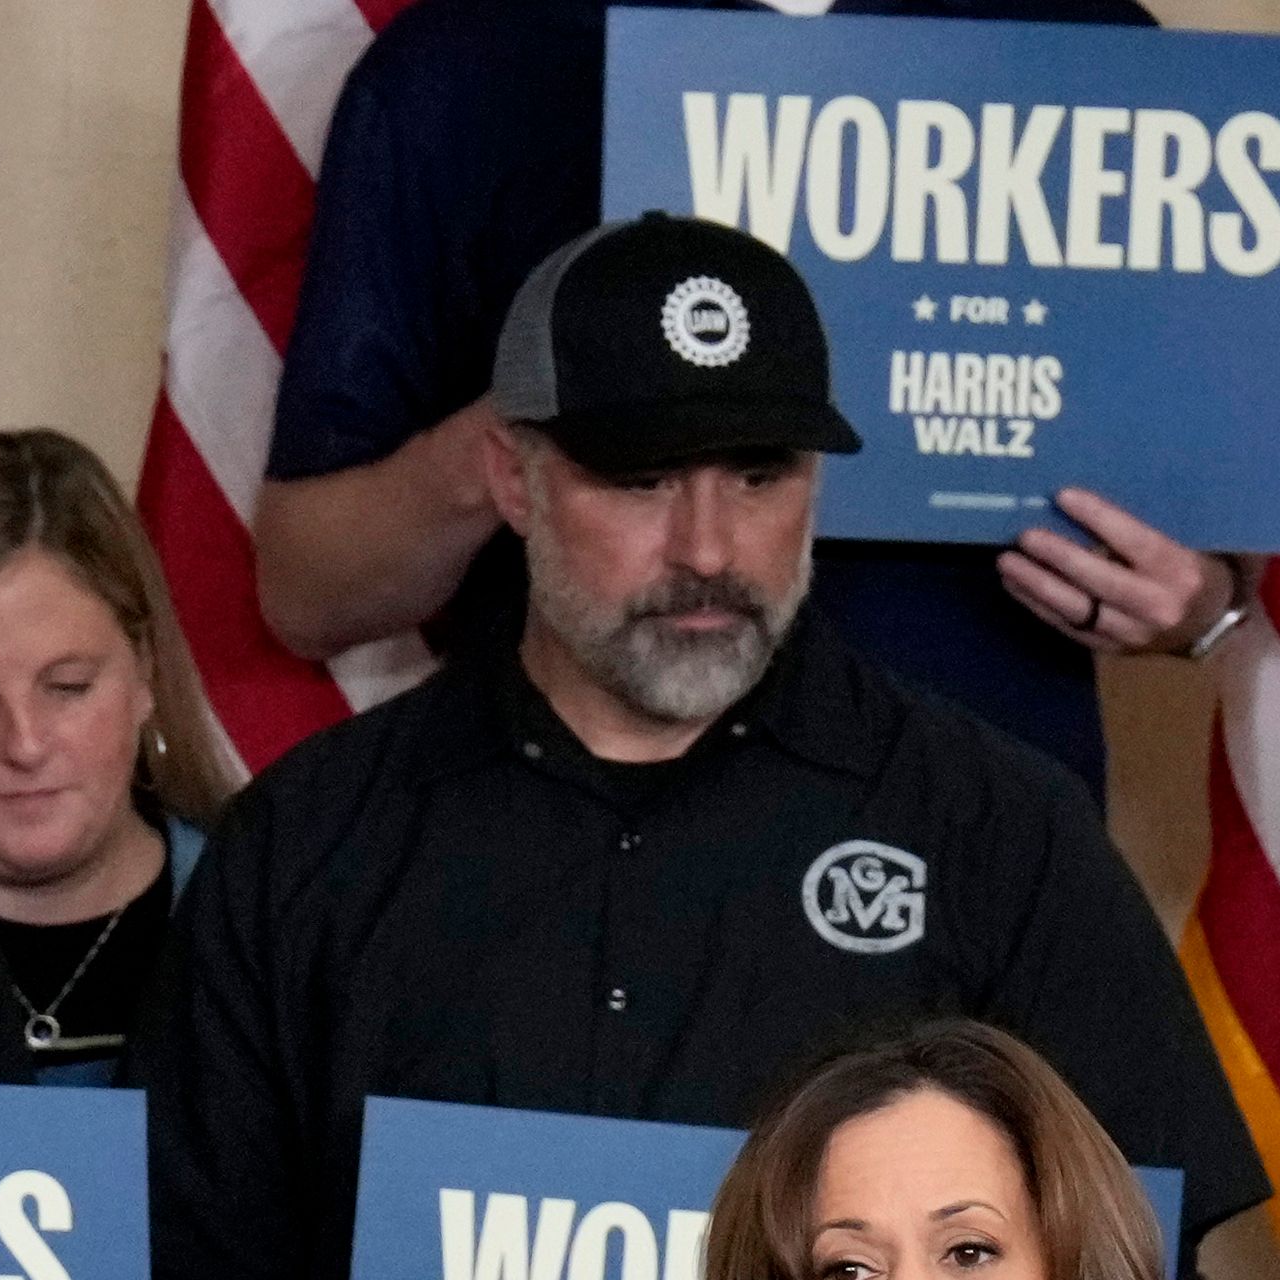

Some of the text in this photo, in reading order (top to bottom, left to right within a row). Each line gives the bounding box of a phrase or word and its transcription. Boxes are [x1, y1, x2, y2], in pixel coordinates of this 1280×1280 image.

[949, 295, 1010, 324] FOR
[889, 351, 1062, 420] HARRIS
[914, 414, 1035, 459] WALZ
